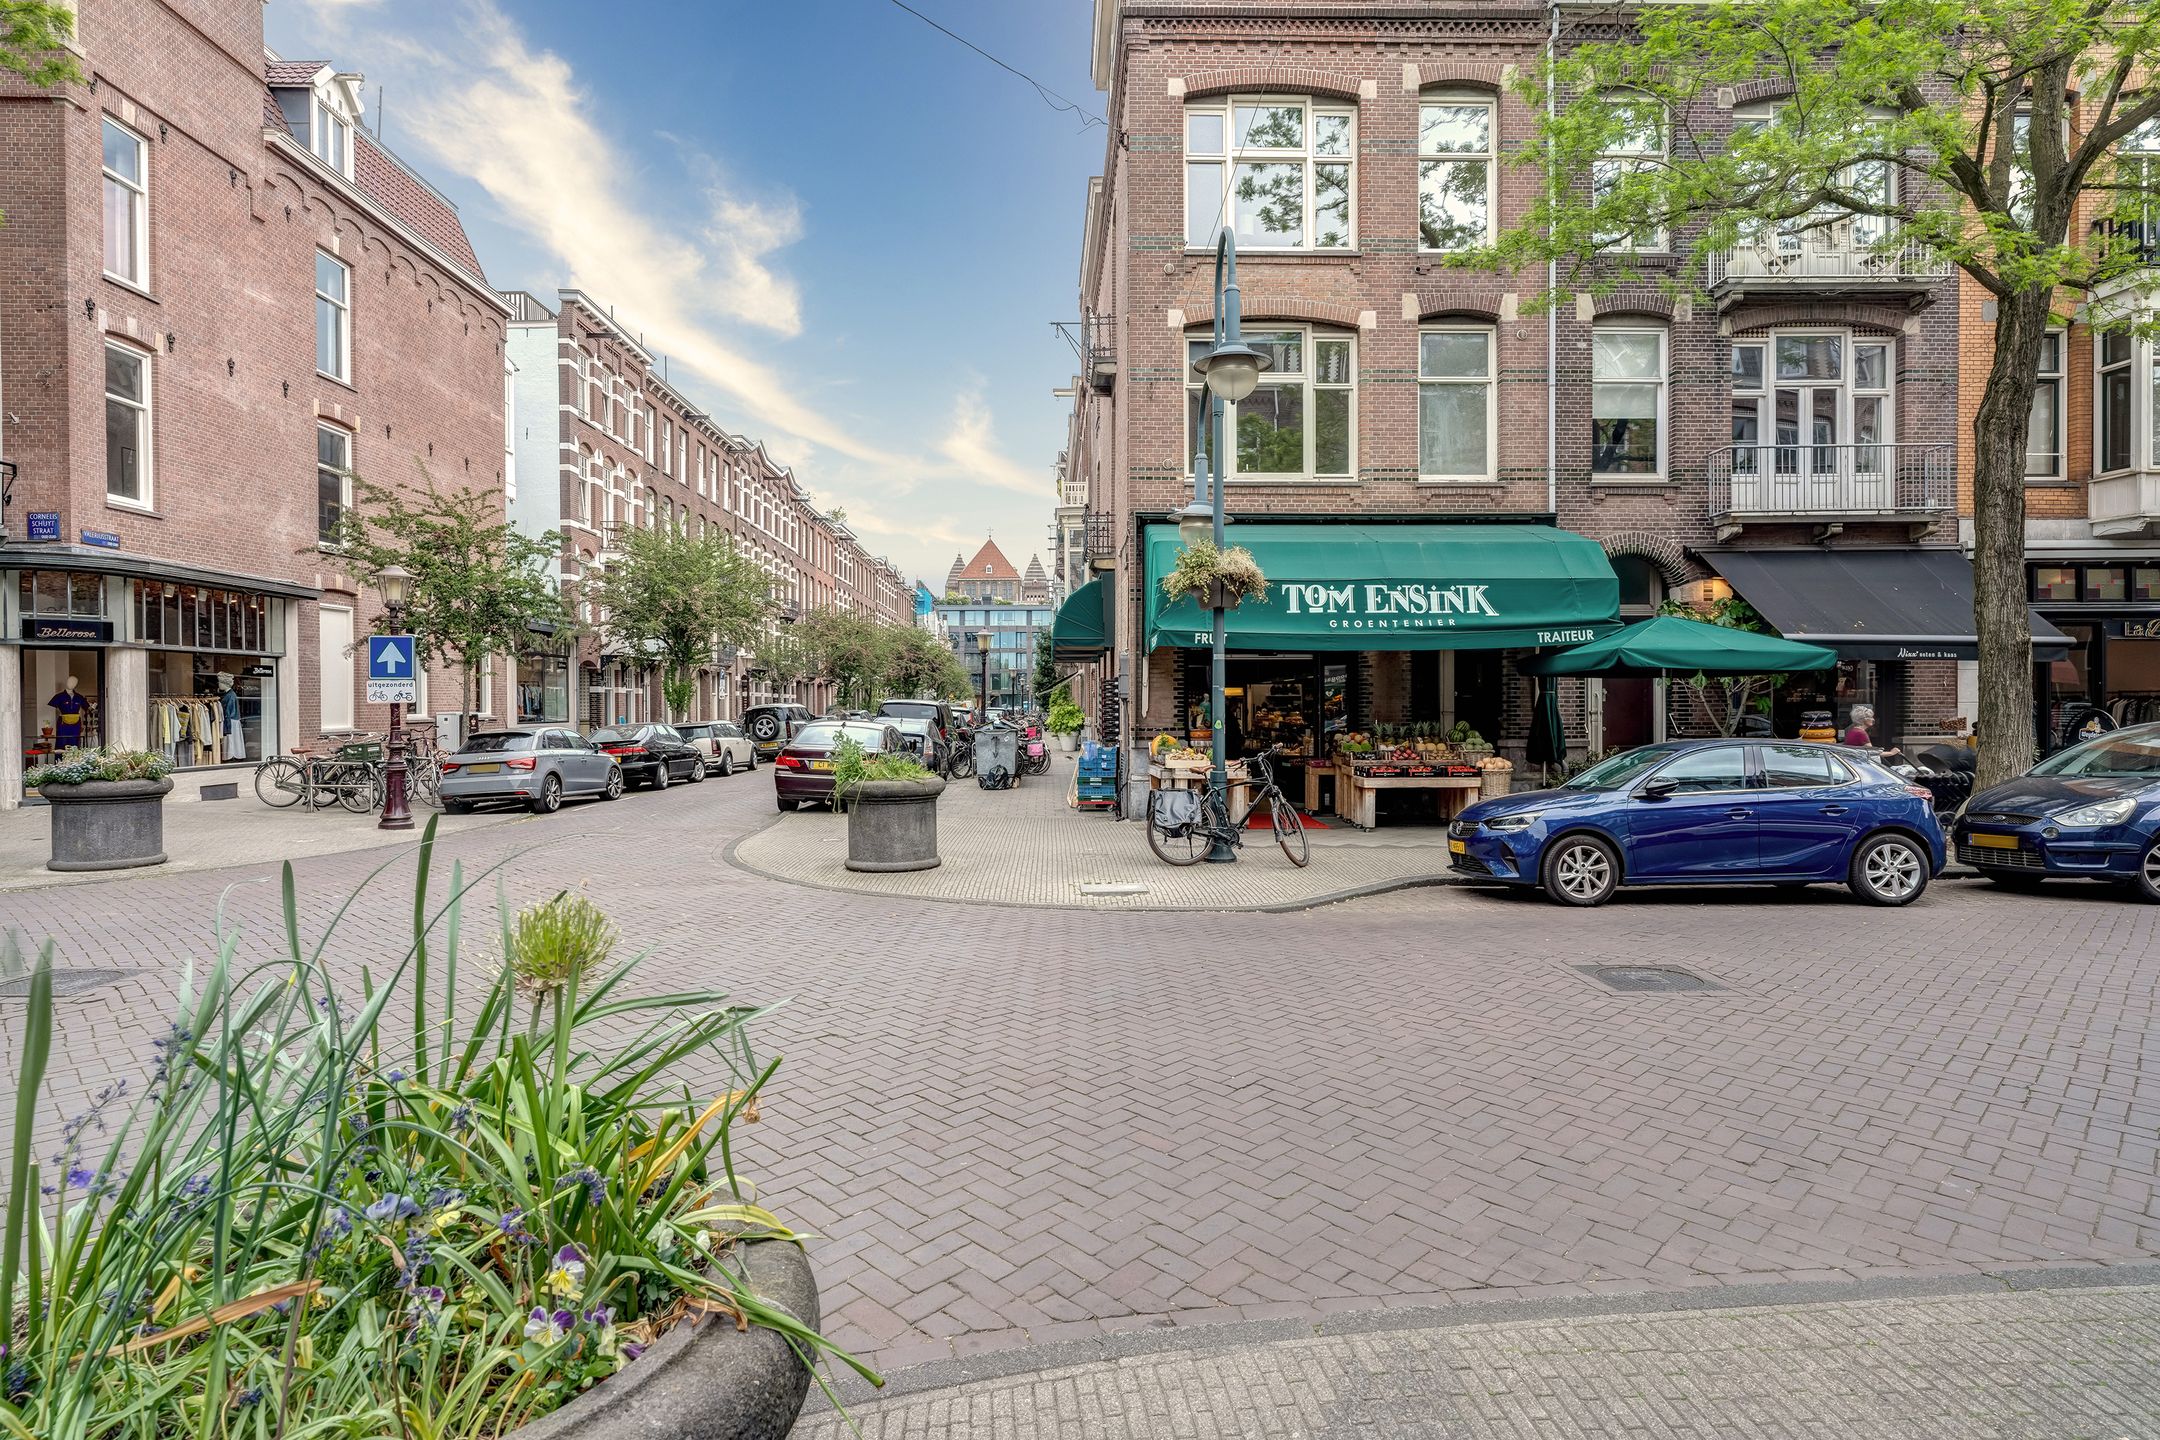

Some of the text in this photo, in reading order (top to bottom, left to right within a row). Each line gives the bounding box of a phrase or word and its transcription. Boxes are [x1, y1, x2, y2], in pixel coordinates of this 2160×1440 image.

[1281, 584, 1356, 613] TOM
[1329, 618, 1456, 628] GROENTENIER
[2124, 621, 2145, 637] La
[1194, 632, 1228, 645] FRUT
[1537, 629, 1595, 643] TRAITEUR
